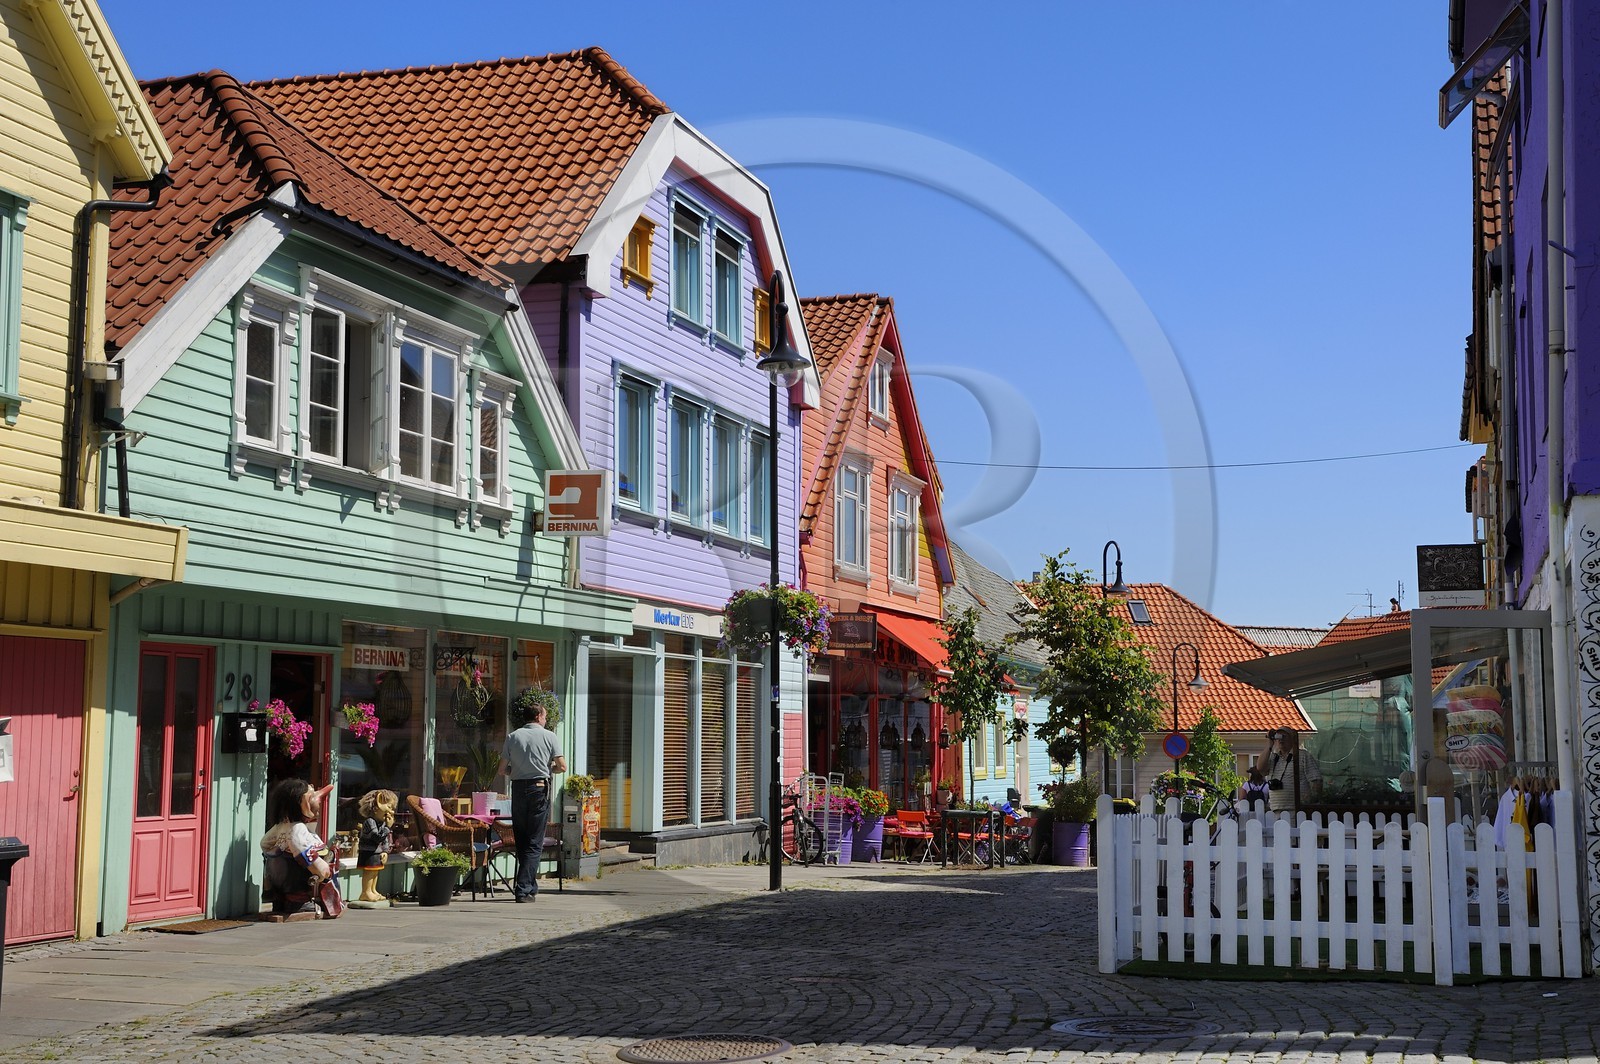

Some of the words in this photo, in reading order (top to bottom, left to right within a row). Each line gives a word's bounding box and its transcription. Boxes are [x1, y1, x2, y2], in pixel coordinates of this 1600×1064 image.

[547, 522, 599, 532] BERNINA
[653, 608, 681, 627] Merkur
[681, 612, 695, 630] EDB
[354, 647, 406, 668] BERNINA
[224, 671, 253, 702] 28
[1448, 739, 1464, 747] SHIT
